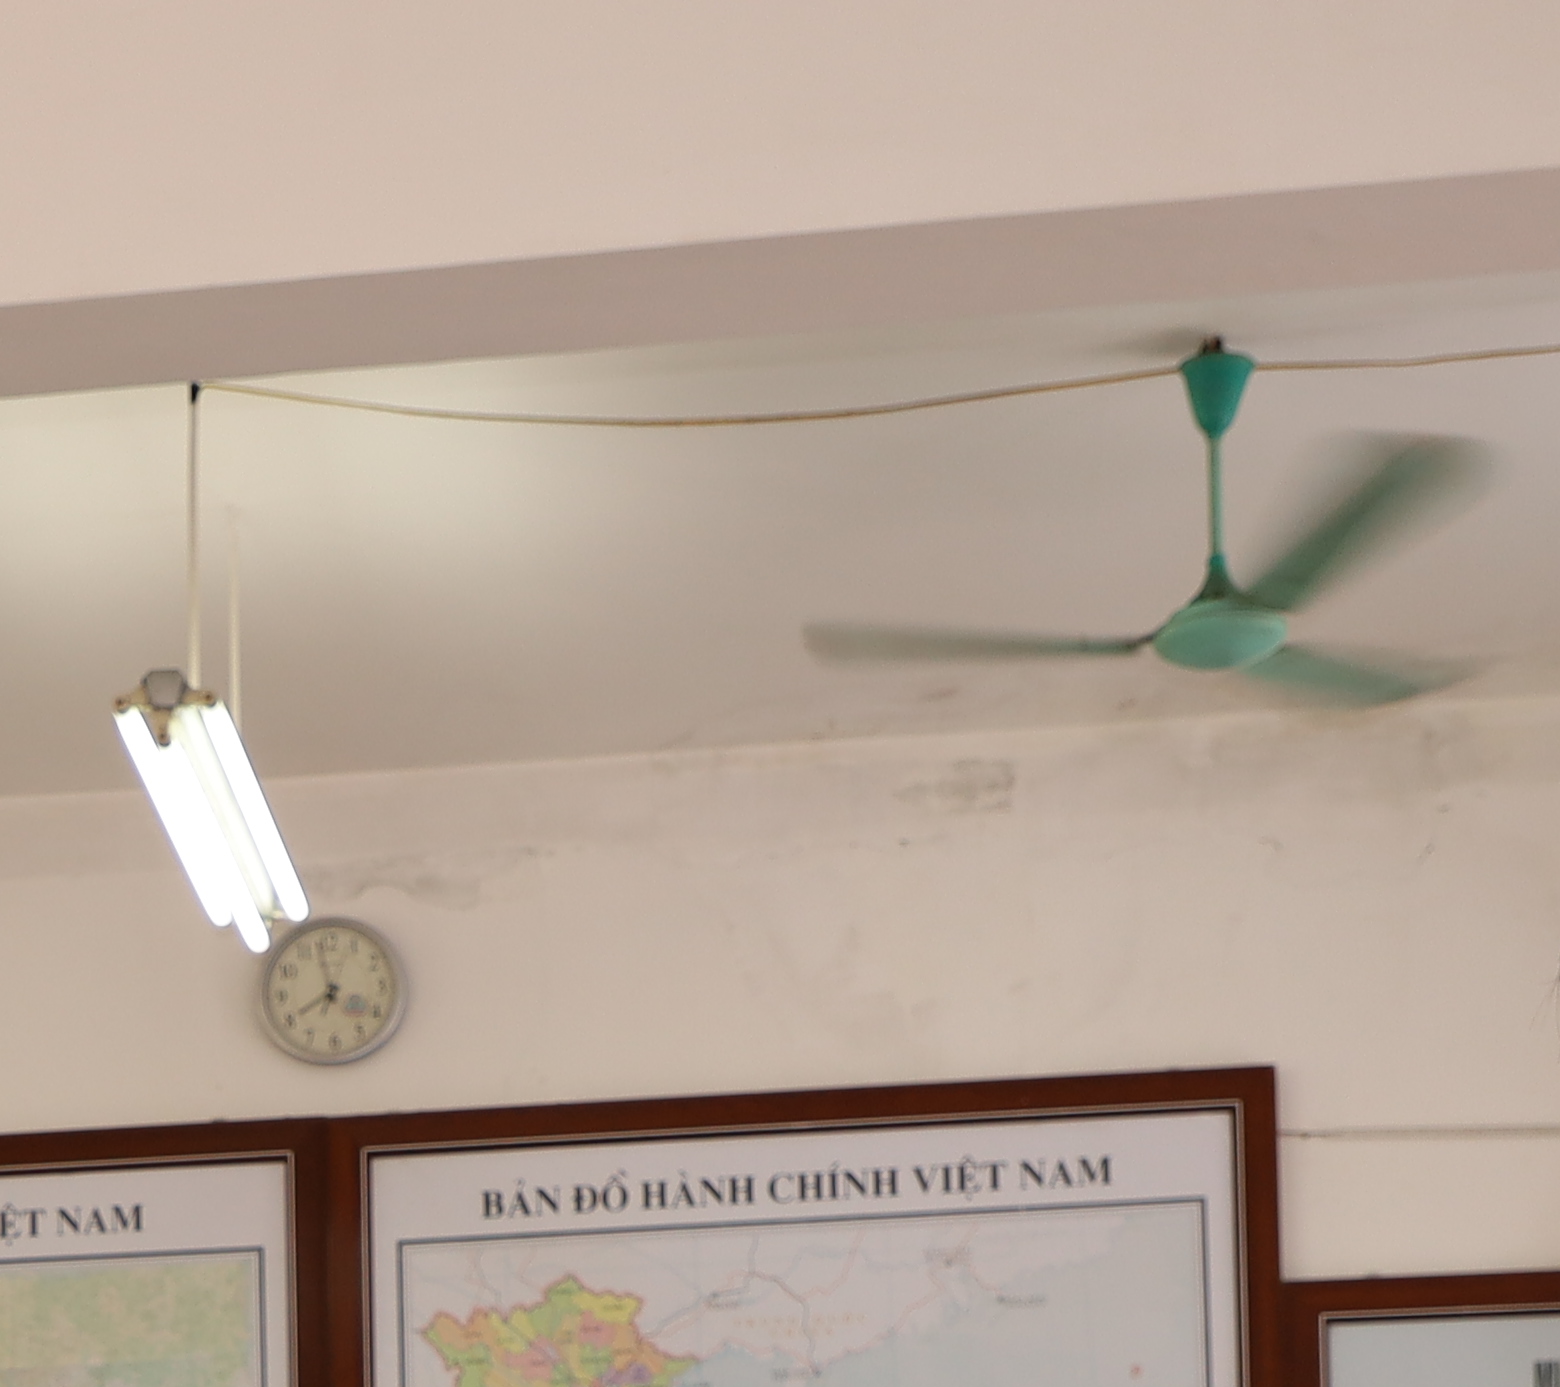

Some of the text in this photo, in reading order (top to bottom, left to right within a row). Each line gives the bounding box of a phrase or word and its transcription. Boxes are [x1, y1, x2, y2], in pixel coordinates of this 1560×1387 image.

[481, 1154, 1113, 1220] BẢN ĐỒ HÀNH CHÍNH VIỆT NAM
[56, 1203, 144, 1235] NAM
